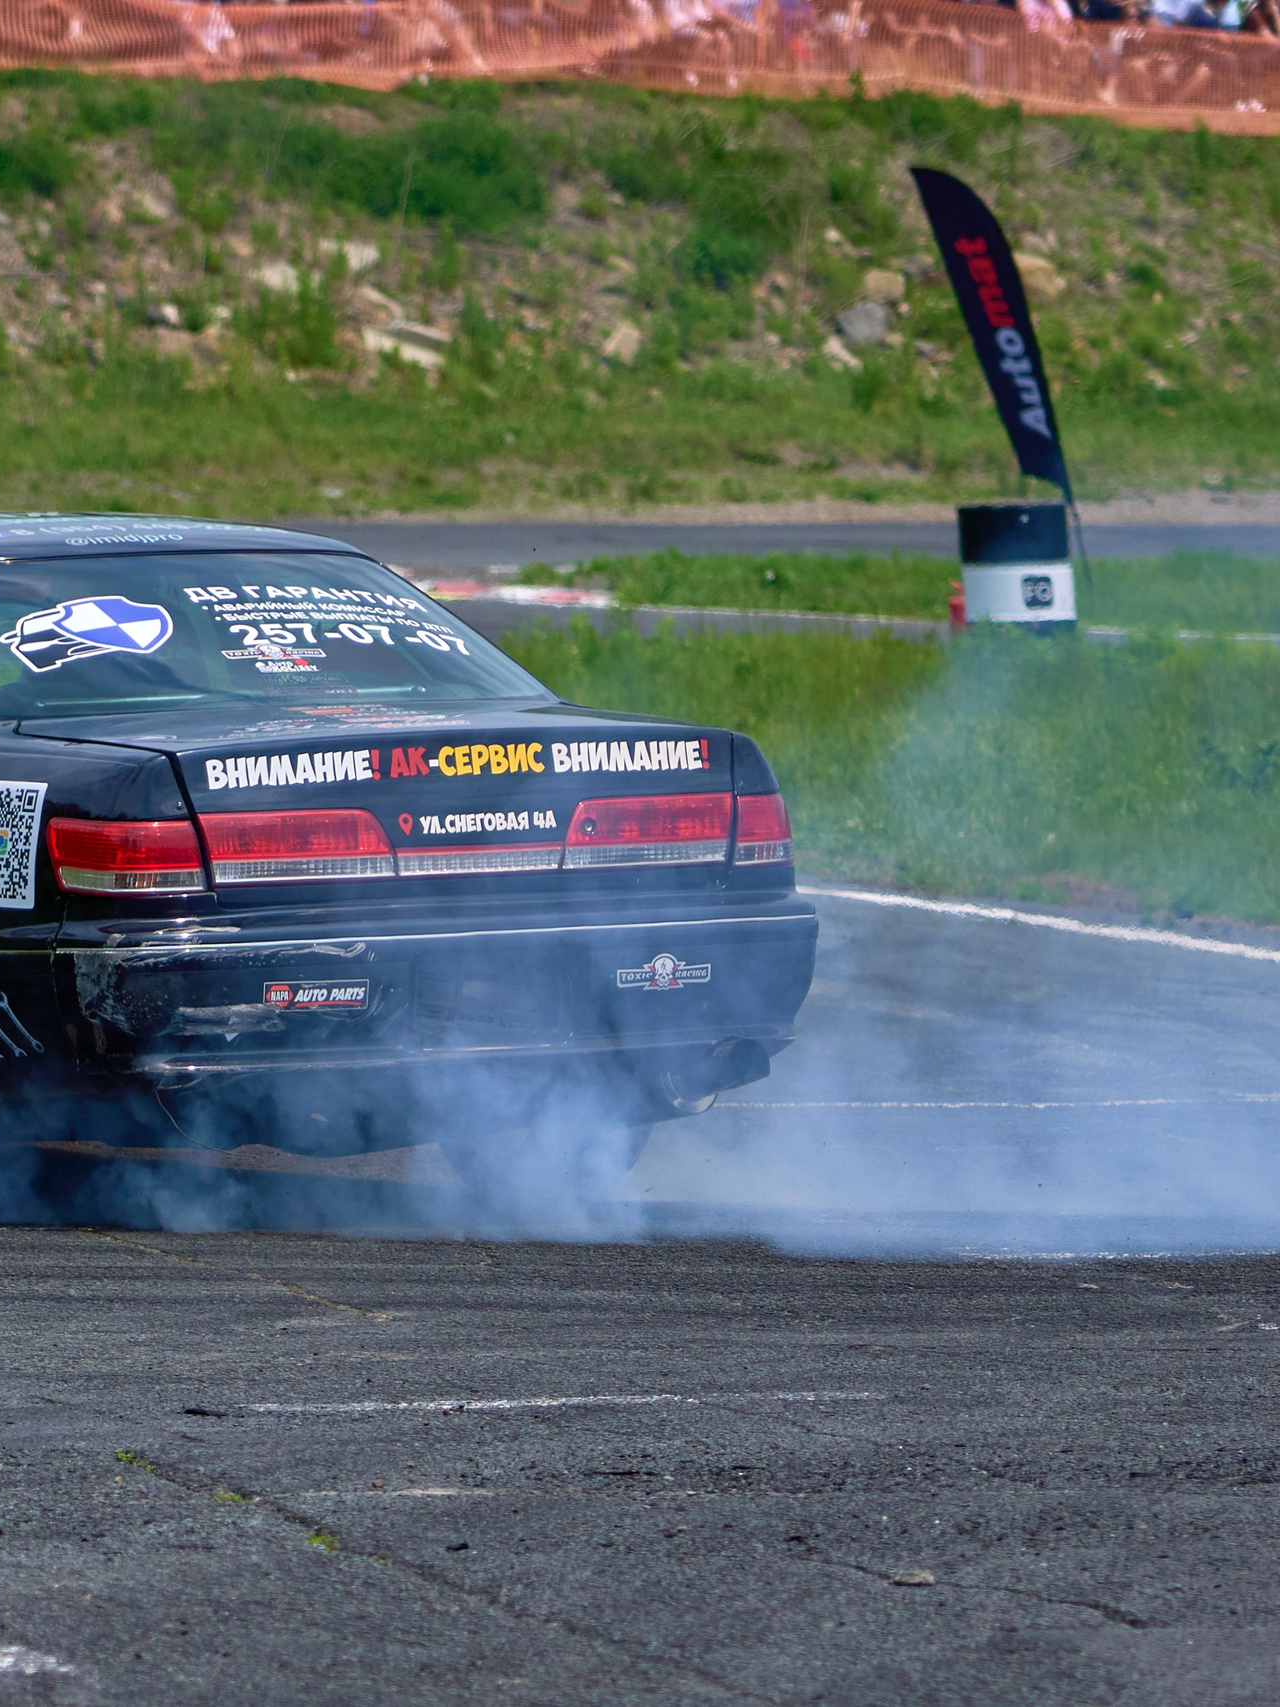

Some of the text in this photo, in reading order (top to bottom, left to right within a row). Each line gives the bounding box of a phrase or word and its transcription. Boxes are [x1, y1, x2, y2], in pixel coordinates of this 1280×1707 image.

[955, 235, 1053, 440] Automat
[183, 585, 428, 613] ДВ ГАРАНТИЯ
[213, 601, 406, 617] АВАРИЙНЫЙ КОМИССАР
[222, 611, 454, 635] БЫСТРЫЕ ВЫПЛАТЫ ПО ДТП
[205, 738, 710, 790] ВНИМАНИЕ! АК-СЕРВИС ВНИМАНИЕ!
[533, 810, 557, 829] 4А
[620, 969, 707, 982] TOXIC RACING
[270, 986, 366, 1003] NAPA AUTO PARTS
